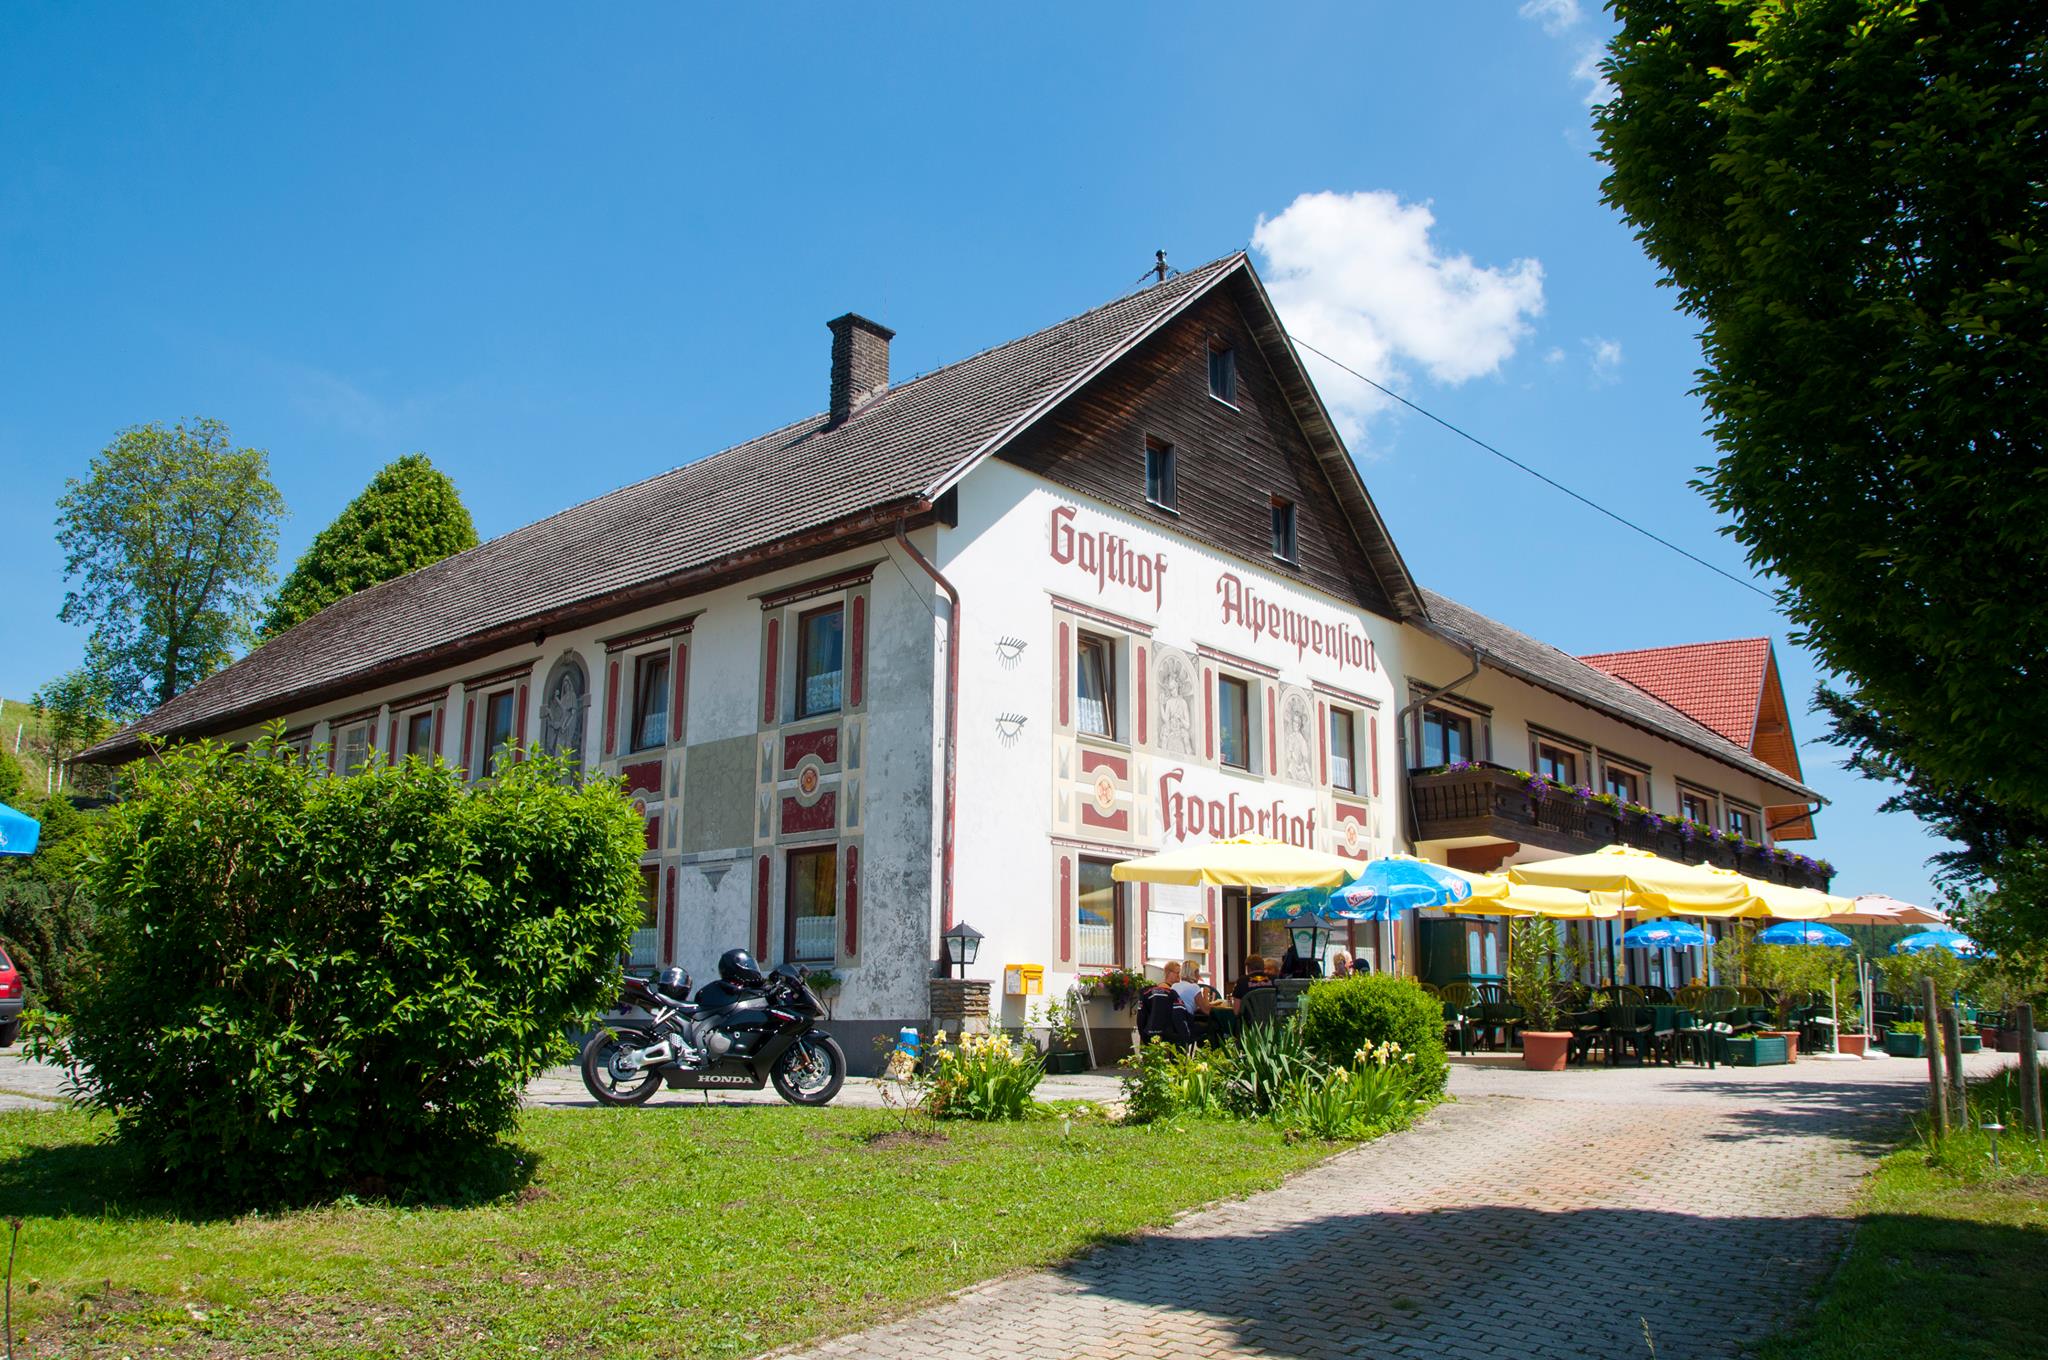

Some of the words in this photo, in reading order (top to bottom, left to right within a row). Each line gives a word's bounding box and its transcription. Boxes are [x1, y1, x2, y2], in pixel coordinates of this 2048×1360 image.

[1050, 505, 1168, 612] Gasthof
[1215, 572, 1377, 673] Alpenpension
[1158, 767, 1317, 850] Koglerhof
[697, 1075, 754, 1084] HONDA
